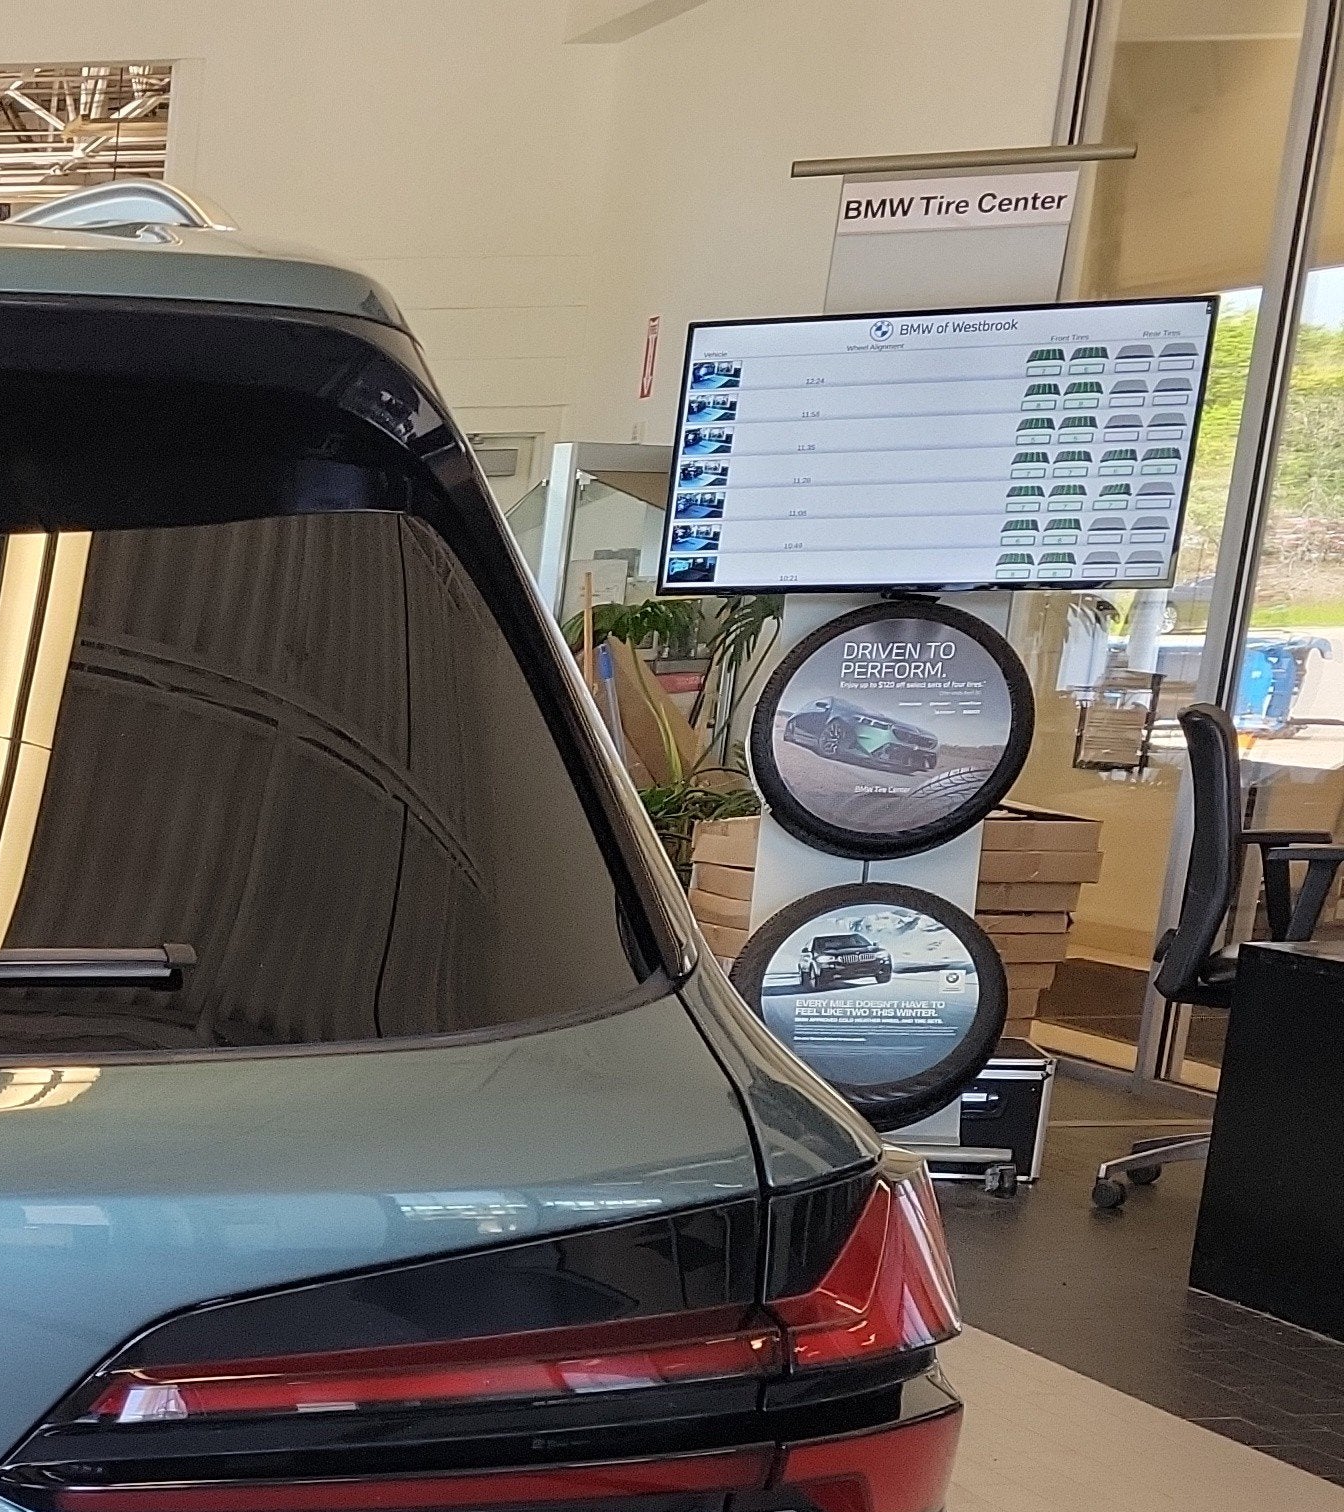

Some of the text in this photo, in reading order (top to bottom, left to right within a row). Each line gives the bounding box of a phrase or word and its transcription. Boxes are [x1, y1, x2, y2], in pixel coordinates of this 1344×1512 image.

[843, 192, 1068, 220] BMW Tire Center
[899, 323, 934, 336] BMW
[936, 321, 949, 334] of
[952, 319, 1018, 333] Westbrook
[843, 641, 956, 660] DRIVEN TO
[840, 661, 947, 679] PERFORM.
[795, 999, 828, 1007] EVERY
[829, 1000, 854, 1008] MILE
[901, 1000, 929, 1008] HAVE
[930, 1000, 946, 1008] TO
[795, 1007, 938, 1017] FEEL LIKE TWO THIS WINTER.
